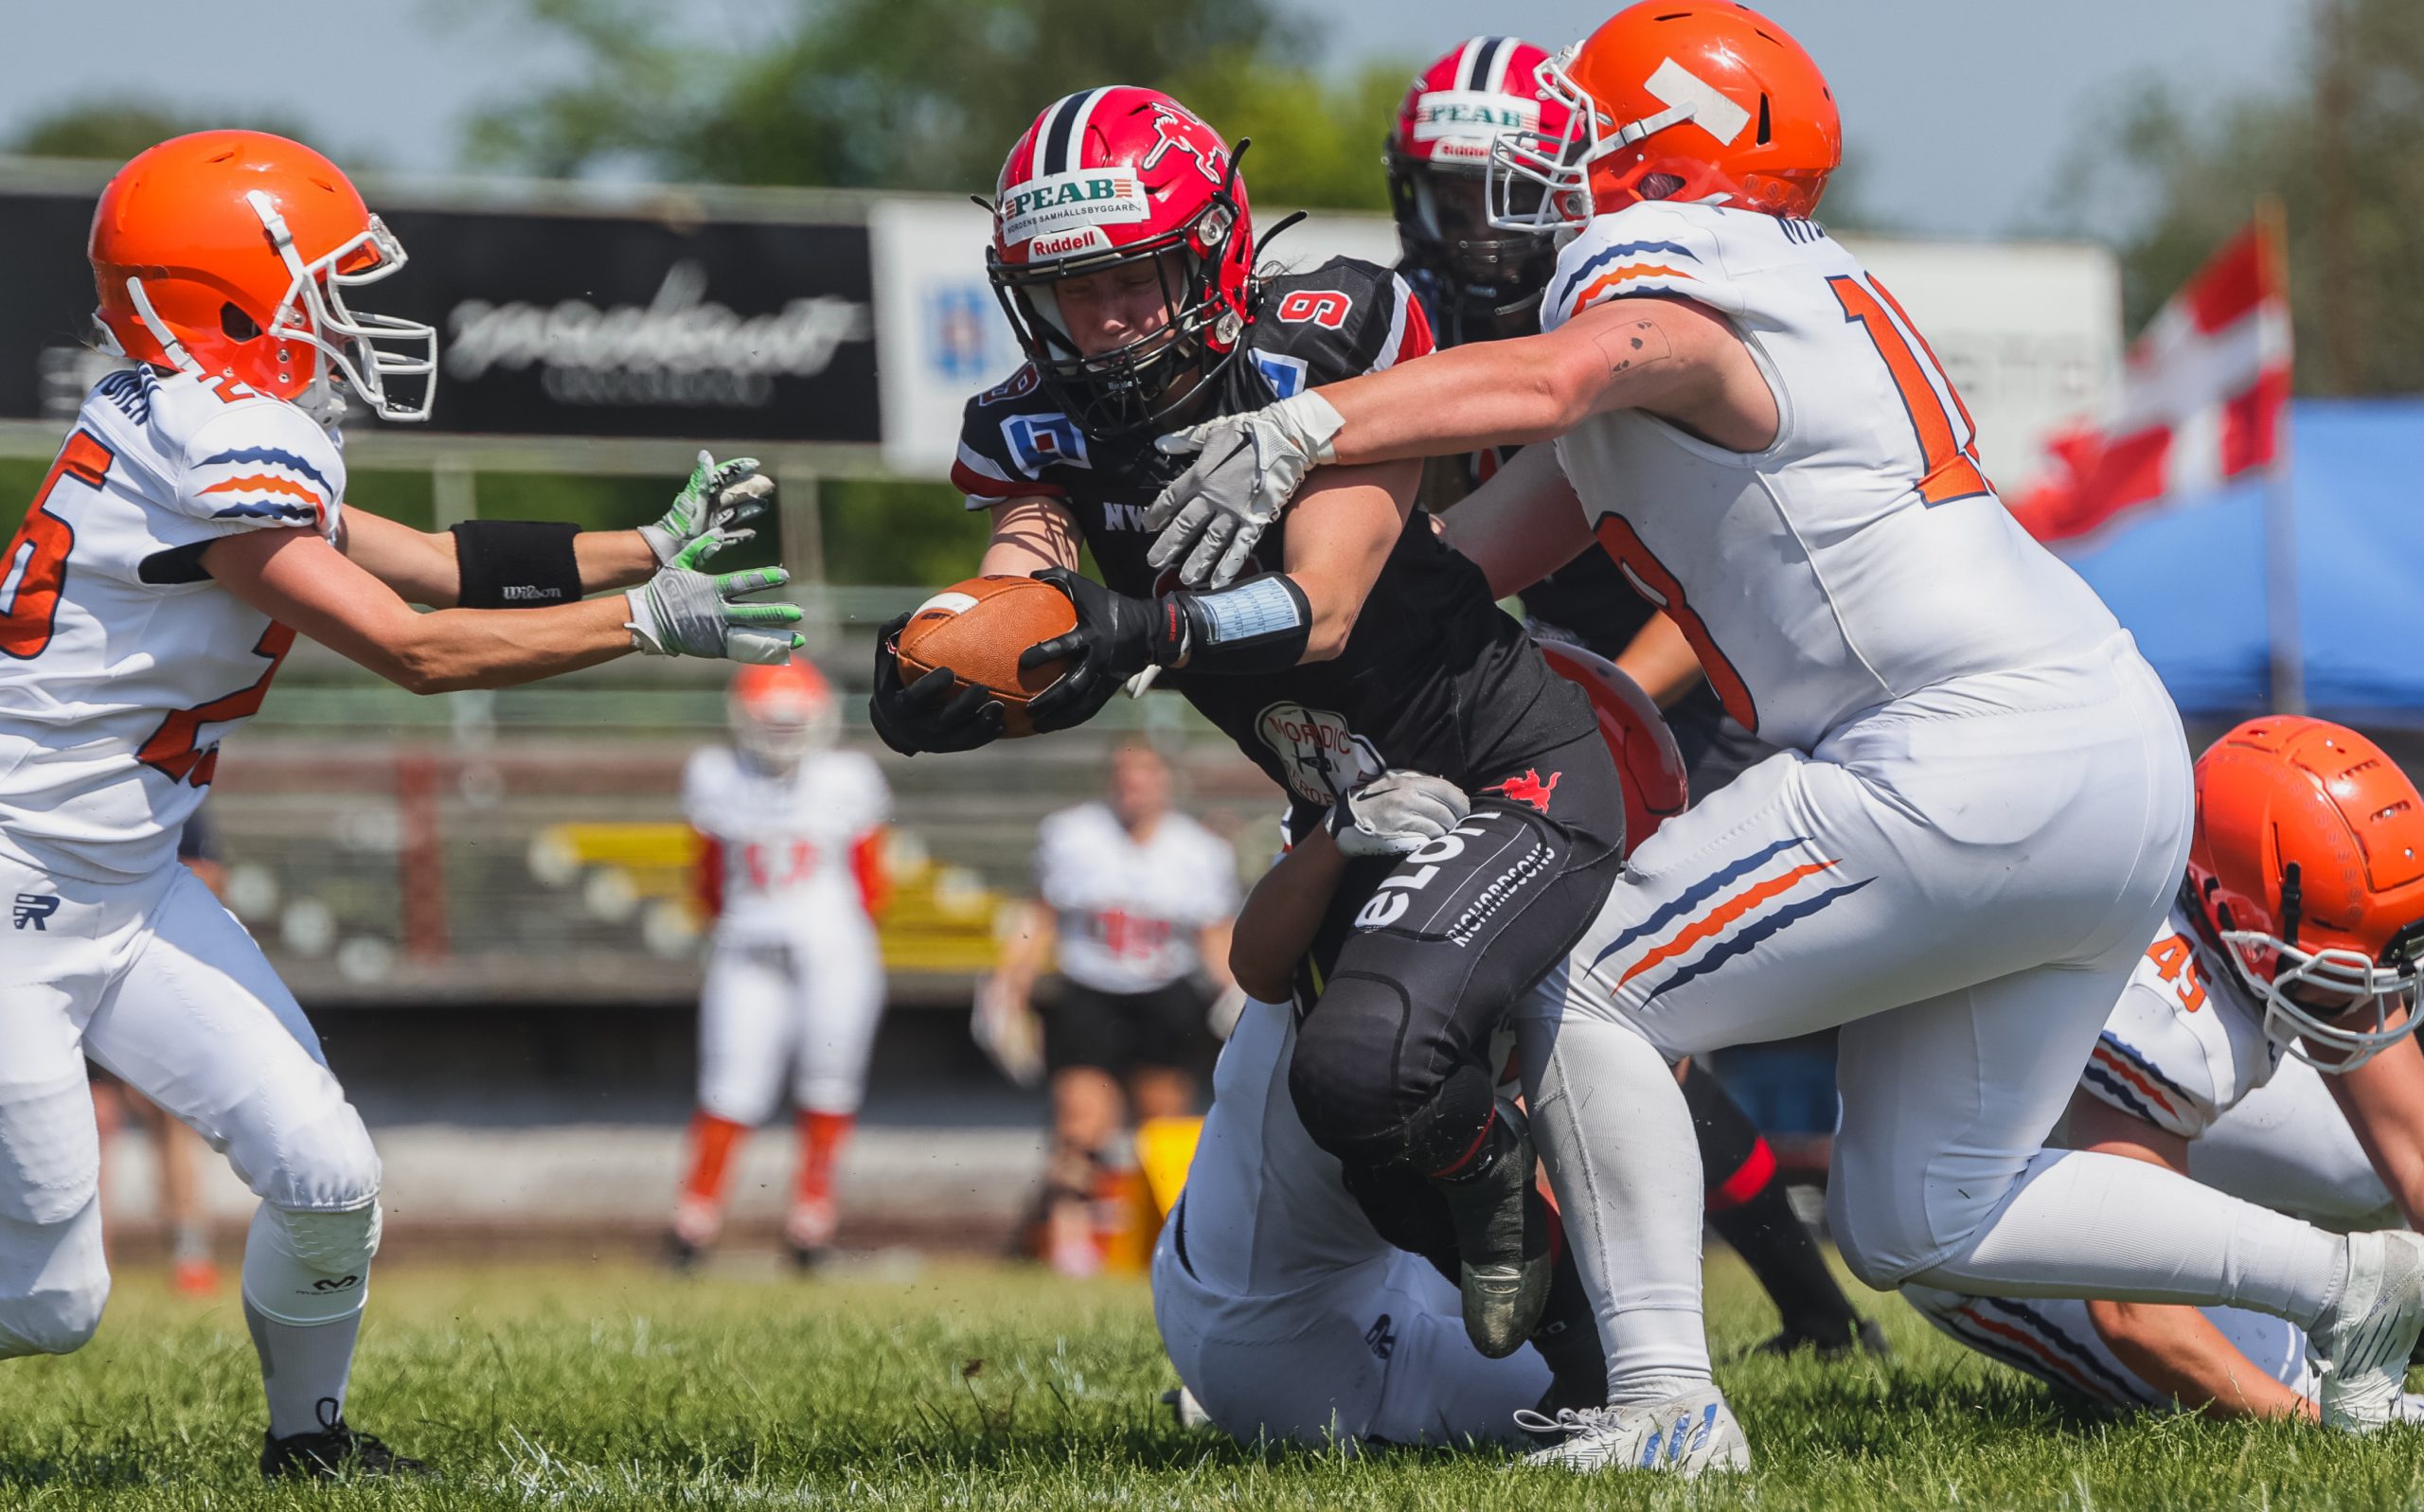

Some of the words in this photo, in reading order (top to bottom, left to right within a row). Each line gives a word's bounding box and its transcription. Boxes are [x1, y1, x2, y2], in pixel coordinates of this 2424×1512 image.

[1431, 103, 1521, 128] PEAB
[1014, 178, 1115, 217] PEAB
[1007, 218, 1038, 235] NORDENS
[1033, 230, 1096, 257] Riddell
[1276, 290, 1353, 330] 9
[502, 584, 562, 600] Wilson
[1267, 716, 1351, 756] NORDIC
[1446, 842, 1556, 948] RICHARDSONS
